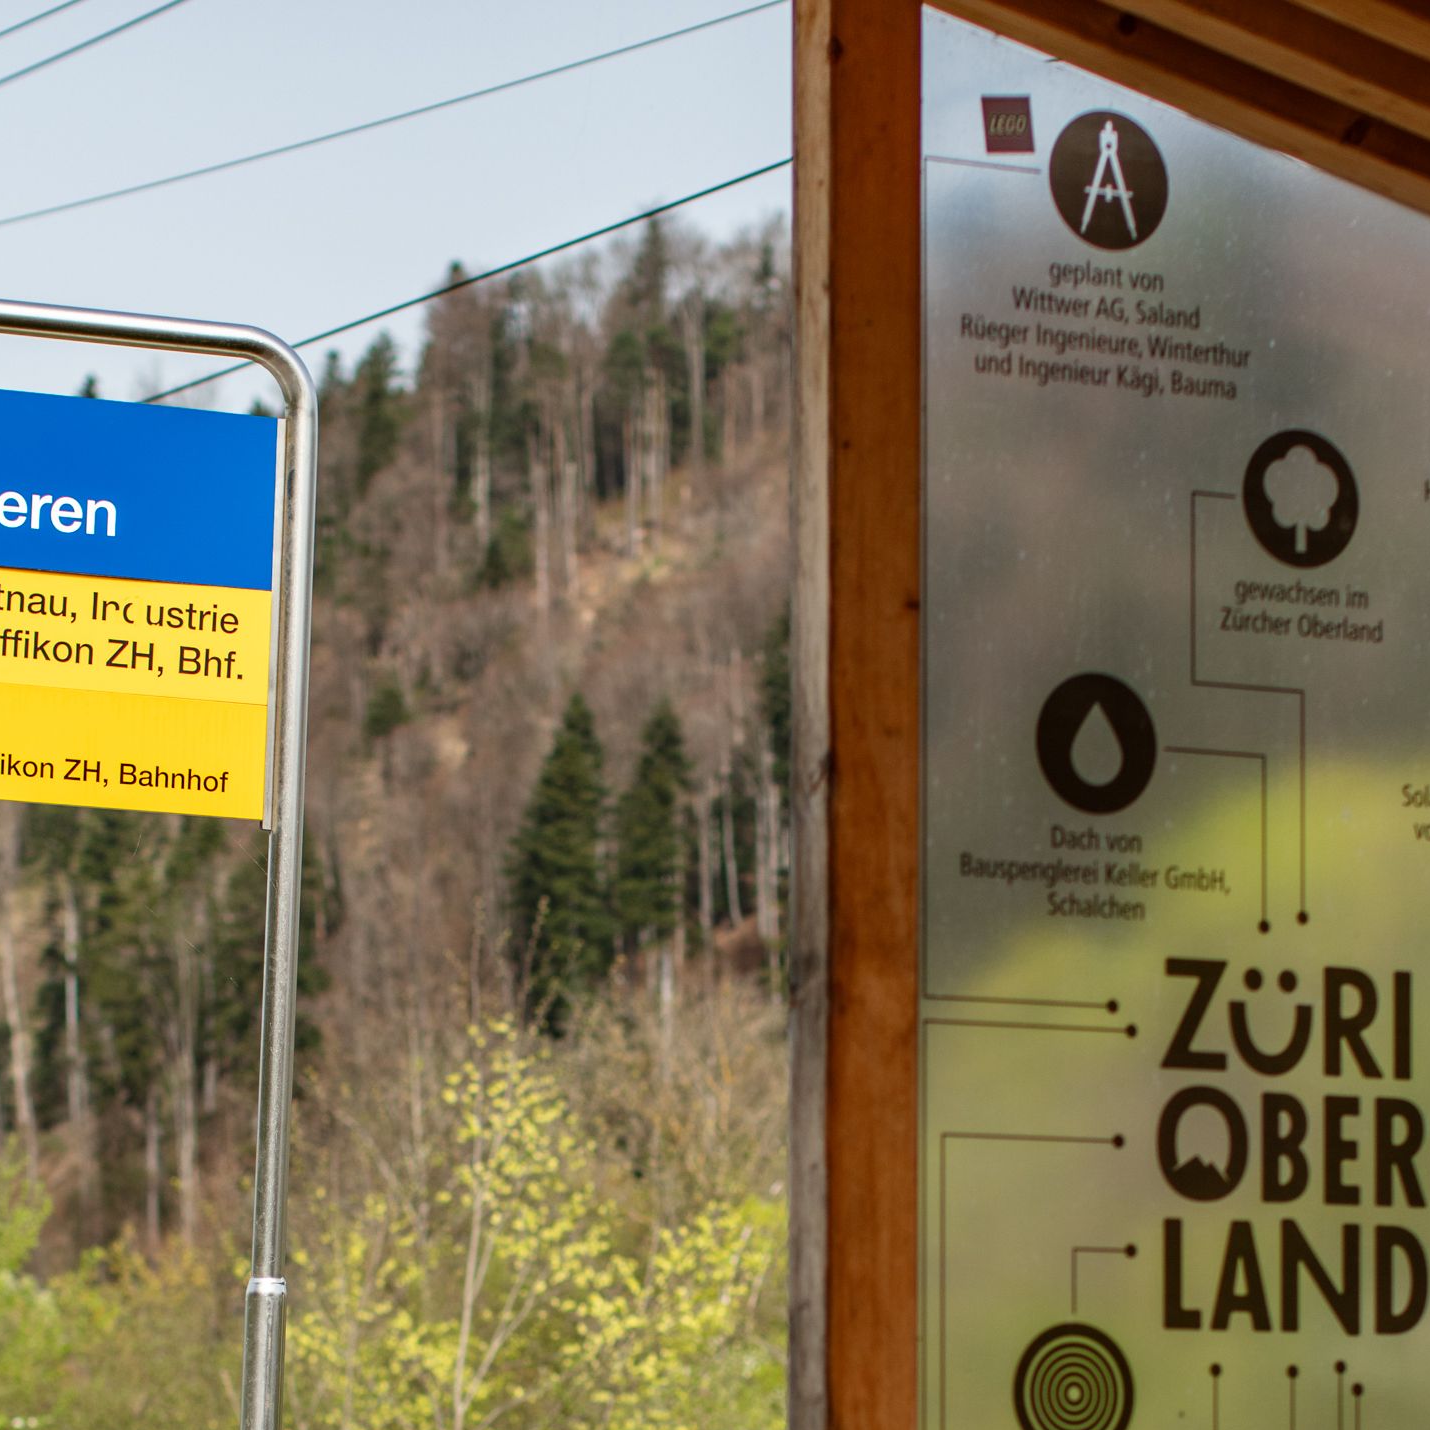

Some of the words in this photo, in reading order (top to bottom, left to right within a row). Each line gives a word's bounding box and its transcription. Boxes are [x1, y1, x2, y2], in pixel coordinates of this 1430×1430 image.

[989, 113, 1027, 136] LEGO
[1049, 261, 1122, 288] geplant
[1129, 270, 1164, 291] von
[1012, 286, 1090, 316] Wittwer
[1096, 297, 1129, 324] AG,
[1136, 302, 1200, 330] Saland
[961, 314, 1029, 348] Rüeger
[1036, 324, 1143, 359] Ingenieure,
[1147, 335, 1251, 368] Winterthur
[975, 352, 1012, 374] und
[1019, 355, 1109, 386] Ingenieur
[1116, 366, 1164, 397] Kägi,
[1171, 373, 1236, 400] Bauma
[1235, 580, 1340, 609] gewachsen
[1346, 584, 1369, 609] im
[1220, 606, 1290, 637] Zürcher
[1297, 613, 1384, 643] Oberland
[105, 639, 164, 678] ZH,
[178, 646, 244, 680] Bhf.
[63, 759, 109, 787] ZH,
[119, 763, 229, 793] Bahnhof
[1050, 825, 1100, 850] Dach
[1105, 833, 1143, 854] von
[960, 852, 1099, 888] Bauspenglerei
[1104, 862, 1158, 888] Keller
[1164, 865, 1231, 896] GmbH,
[1047, 891, 1146, 921] Schalchen
[1160, 957, 1414, 1081] ZÜRI
[1156, 1085, 1428, 1208] OBER
[1163, 1217, 1430, 1338] LAND
